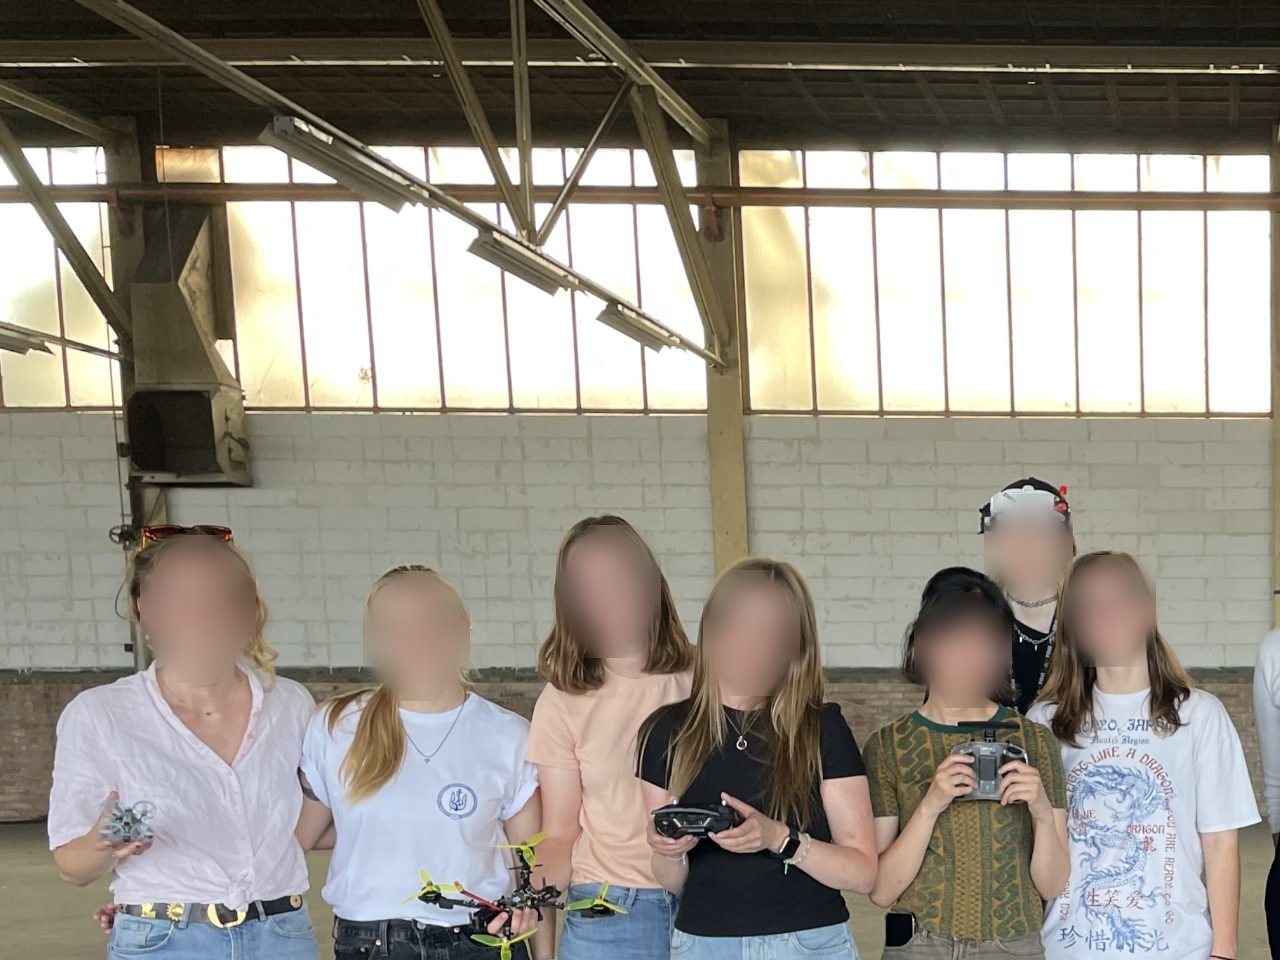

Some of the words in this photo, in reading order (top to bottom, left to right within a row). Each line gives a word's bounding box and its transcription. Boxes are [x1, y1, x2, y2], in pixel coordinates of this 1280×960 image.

[1126, 747, 1137, 759] A
[1140, 753, 1174, 795] DRAGON
[1165, 833, 1176, 852] ARE
